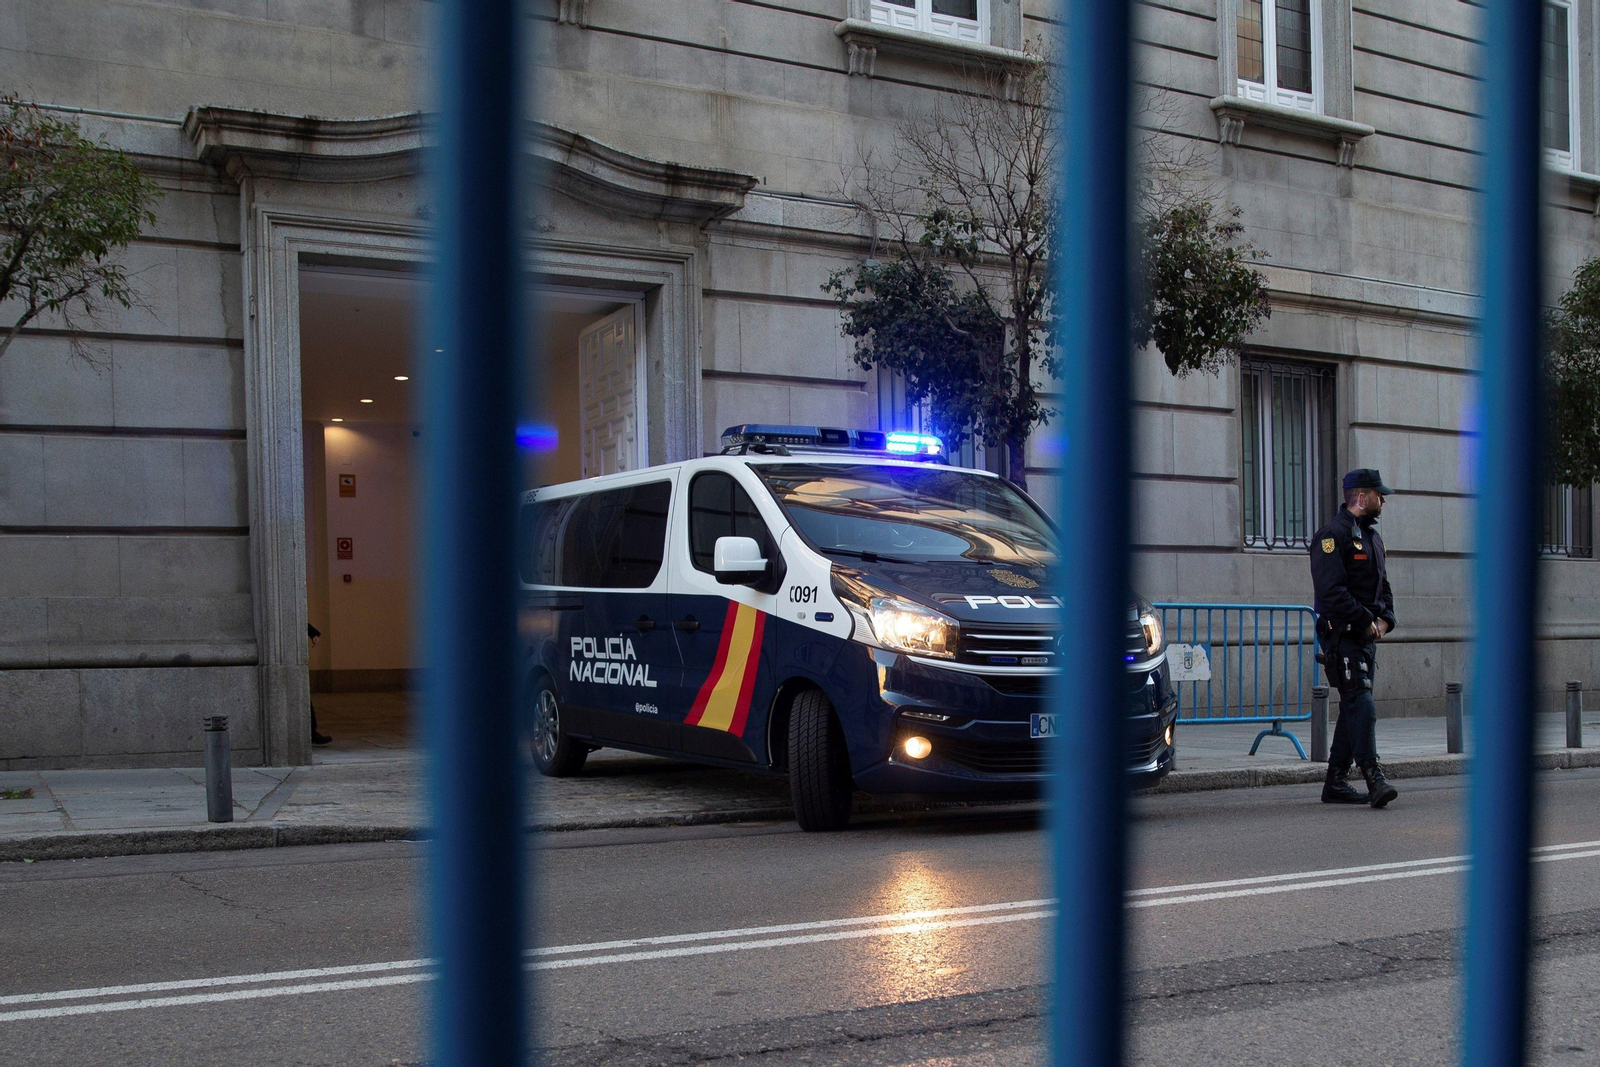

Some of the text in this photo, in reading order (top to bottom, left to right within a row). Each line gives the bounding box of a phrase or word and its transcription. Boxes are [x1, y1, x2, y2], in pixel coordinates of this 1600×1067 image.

[963, 595, 1065, 609] POLI
[570, 632, 637, 661] POLICÍA
[569, 660, 658, 687] NACIONAL
[635, 702, 659, 714] @policia
